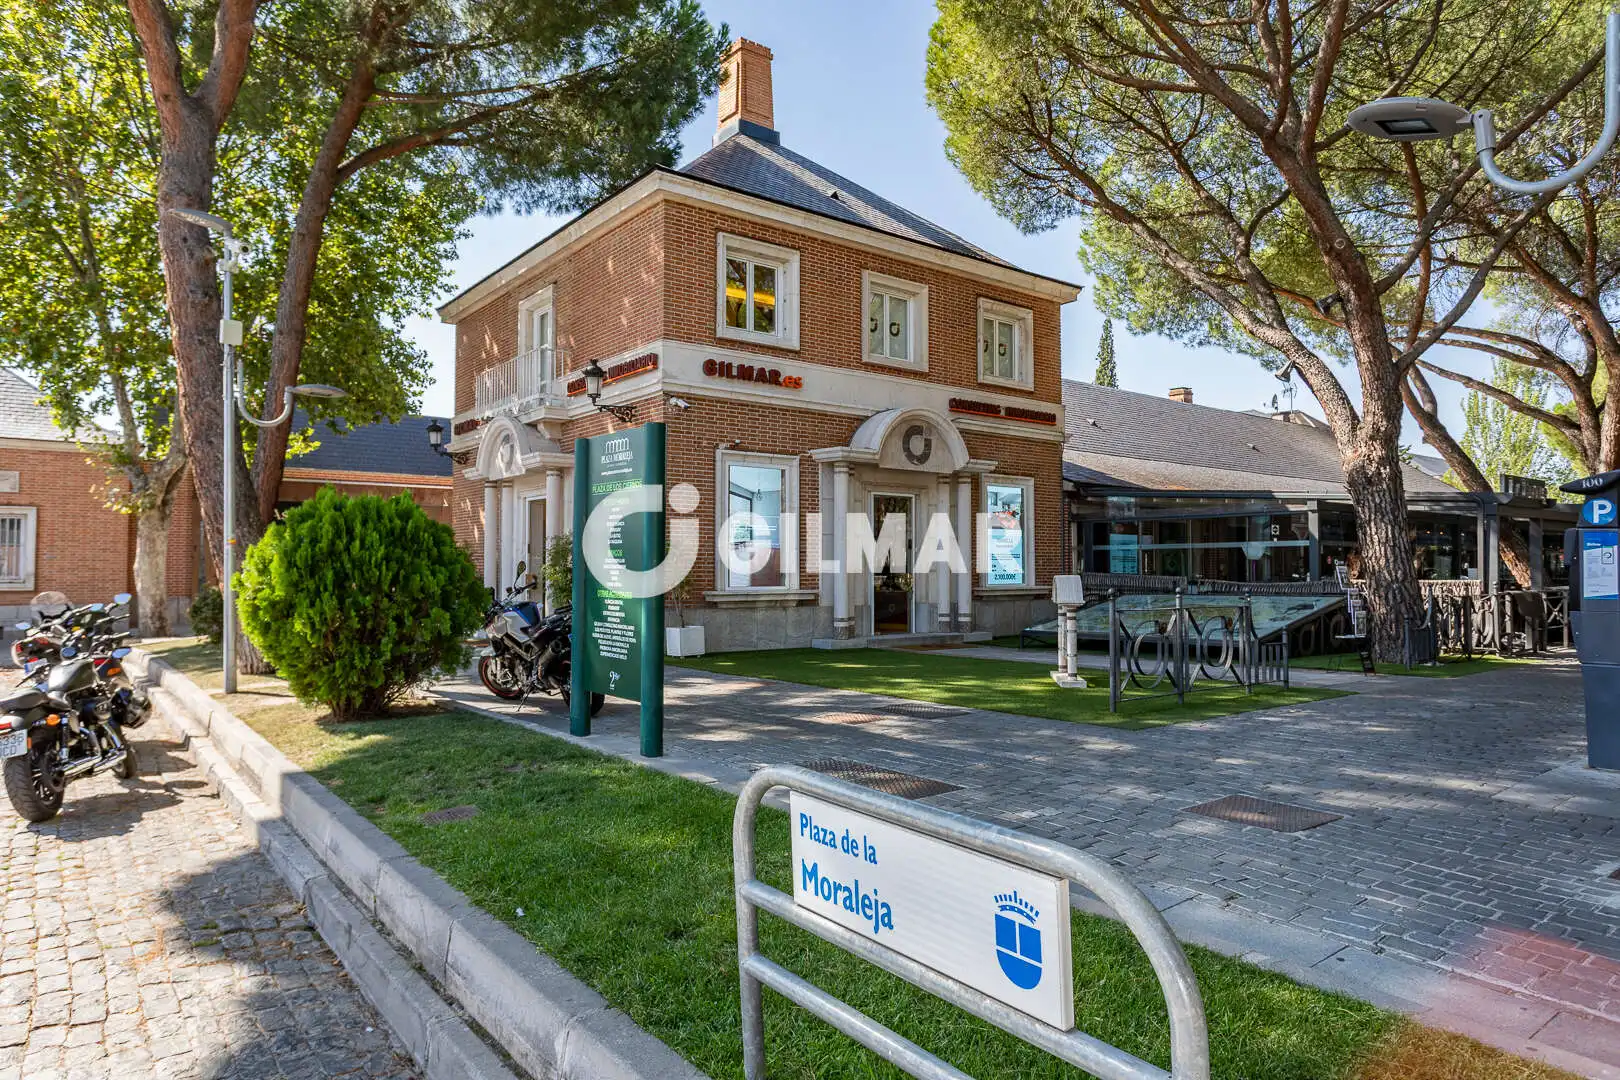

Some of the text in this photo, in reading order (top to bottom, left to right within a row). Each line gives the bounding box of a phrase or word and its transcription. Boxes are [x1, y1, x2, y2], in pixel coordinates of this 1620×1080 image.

[1593, 500, 1612, 523] P
[800, 812, 877, 864] Plaza de la
[802, 858, 893, 933] Moraleja
